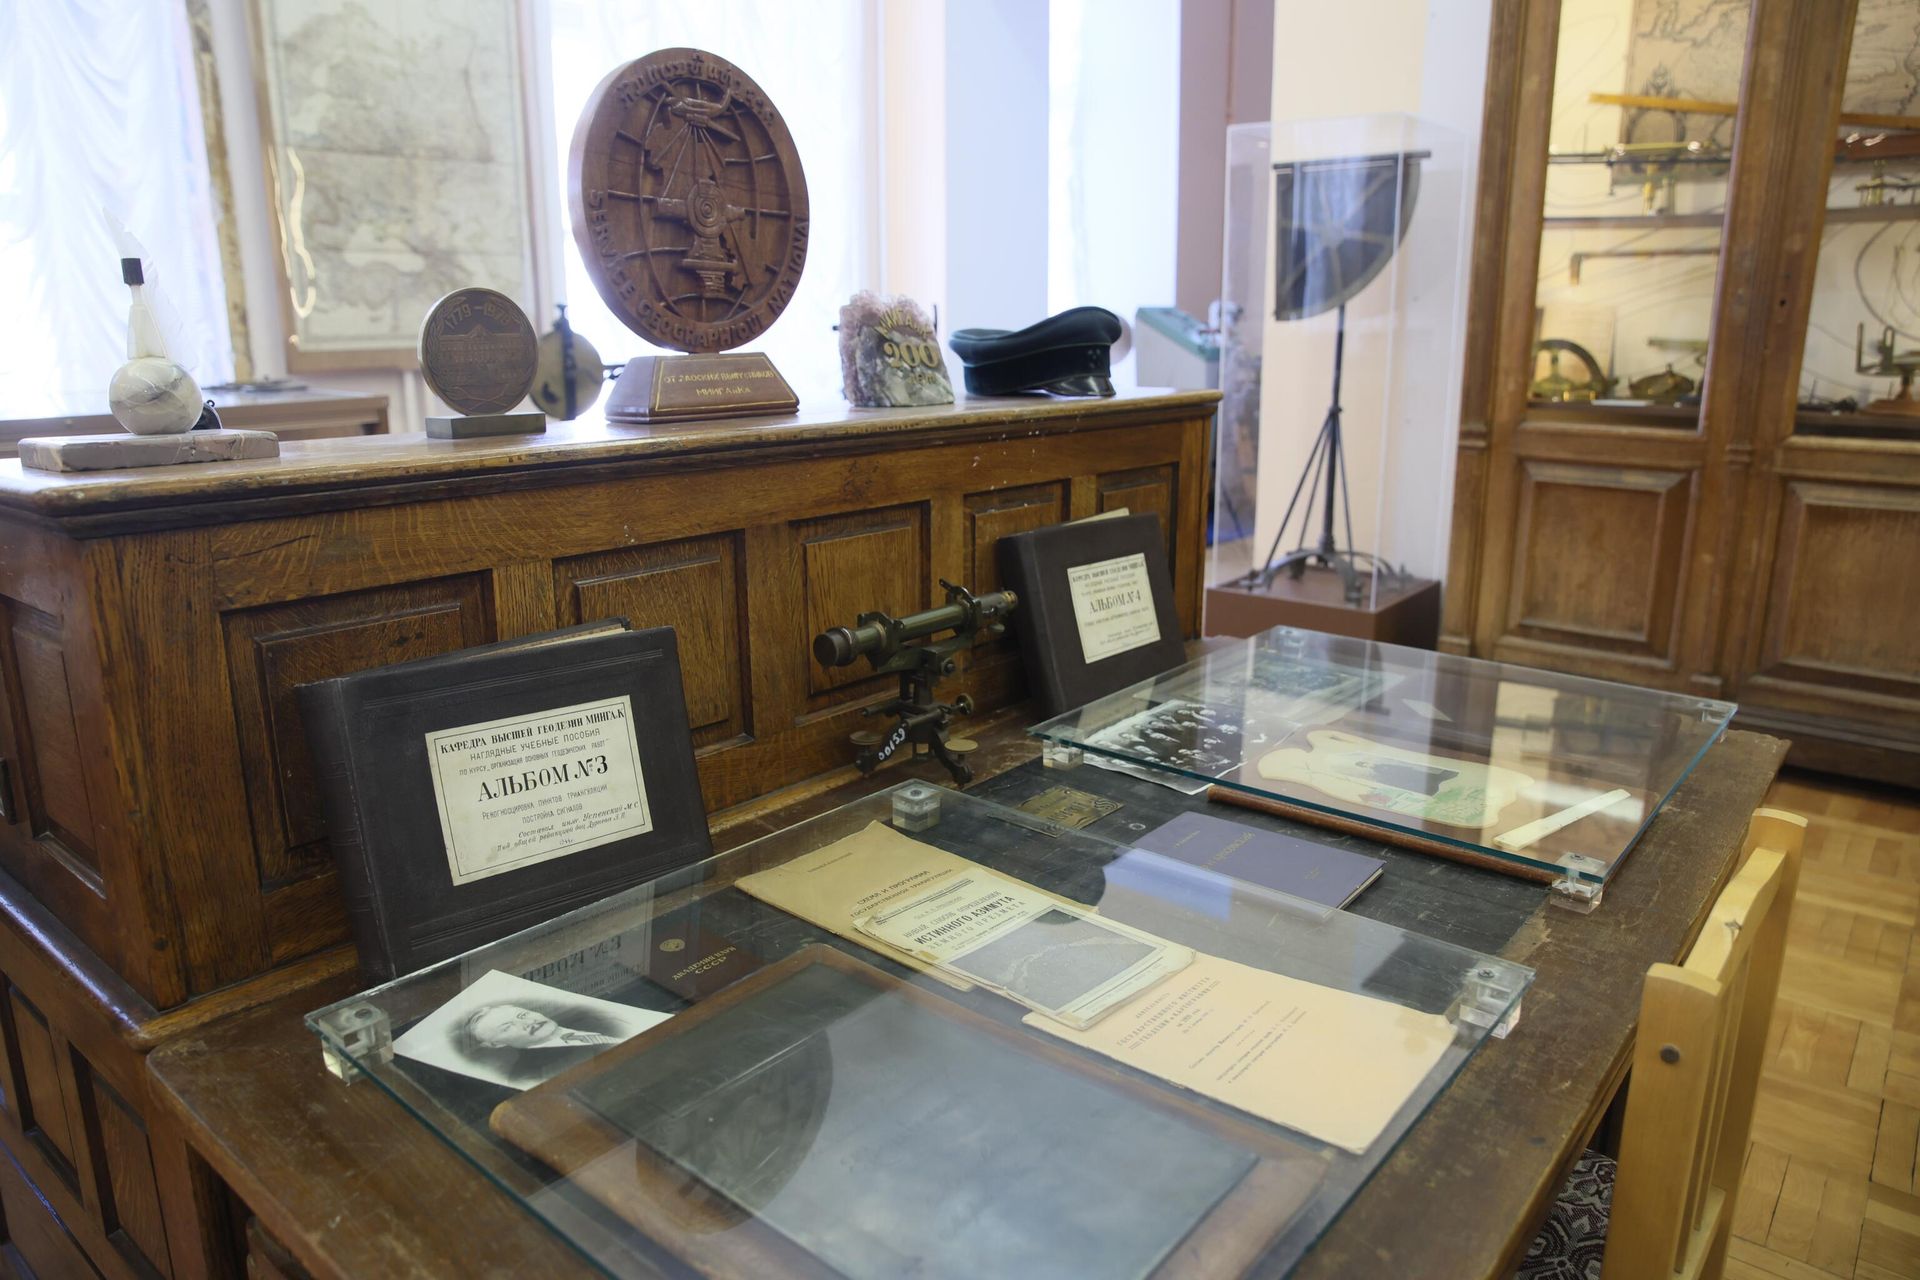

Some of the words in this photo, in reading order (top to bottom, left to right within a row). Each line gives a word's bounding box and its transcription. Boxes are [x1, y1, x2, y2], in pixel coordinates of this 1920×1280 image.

[883, 341, 940, 369] 200
[441, 737, 487, 755] КАФЕДРА
[491, 726, 533, 745] ВЫСШЕЙ
[537, 717, 583, 735] ГЕОДЕЗИИ
[470, 744, 517, 761] НАГЛЯДНЫЕ
[520, 736, 560, 751] УЧЕБНЫЕ
[563, 728, 601, 743] ПОСОБИЯ
[478, 763, 569, 802] АЛЬБОМ
[914, 914, 973, 945] ИСТИННОГО
[971, 895, 1016, 918] АЗИМУТА
[695, 956, 727, 974] СССР
